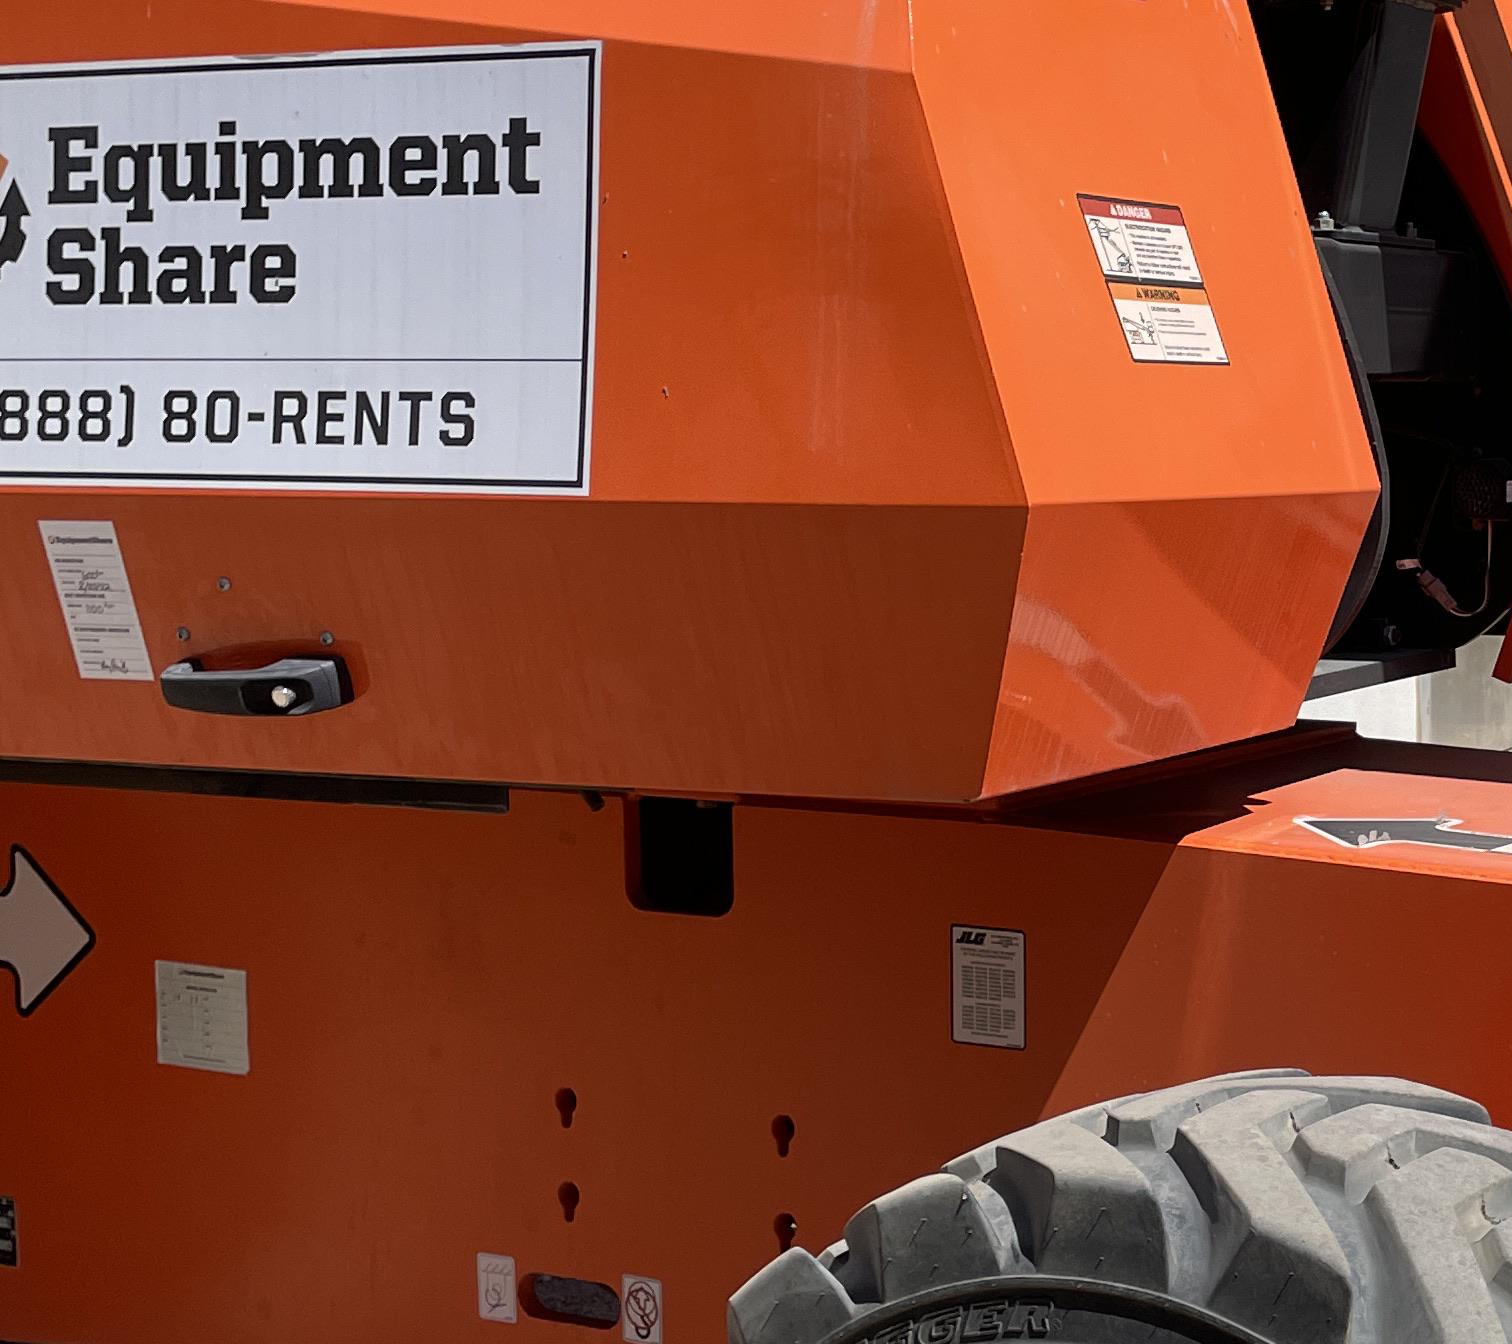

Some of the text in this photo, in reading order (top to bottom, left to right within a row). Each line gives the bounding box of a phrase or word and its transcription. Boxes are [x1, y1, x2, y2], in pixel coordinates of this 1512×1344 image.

[47, 117, 541, 222] Equipment
[1116, 205, 1152, 219] DANGER
[46, 227, 296, 305] Share
[1142, 288, 1180, 301] WARNING
[162, 389, 476, 447] 80-RENTS
[955, 931, 987, 945] JLG
